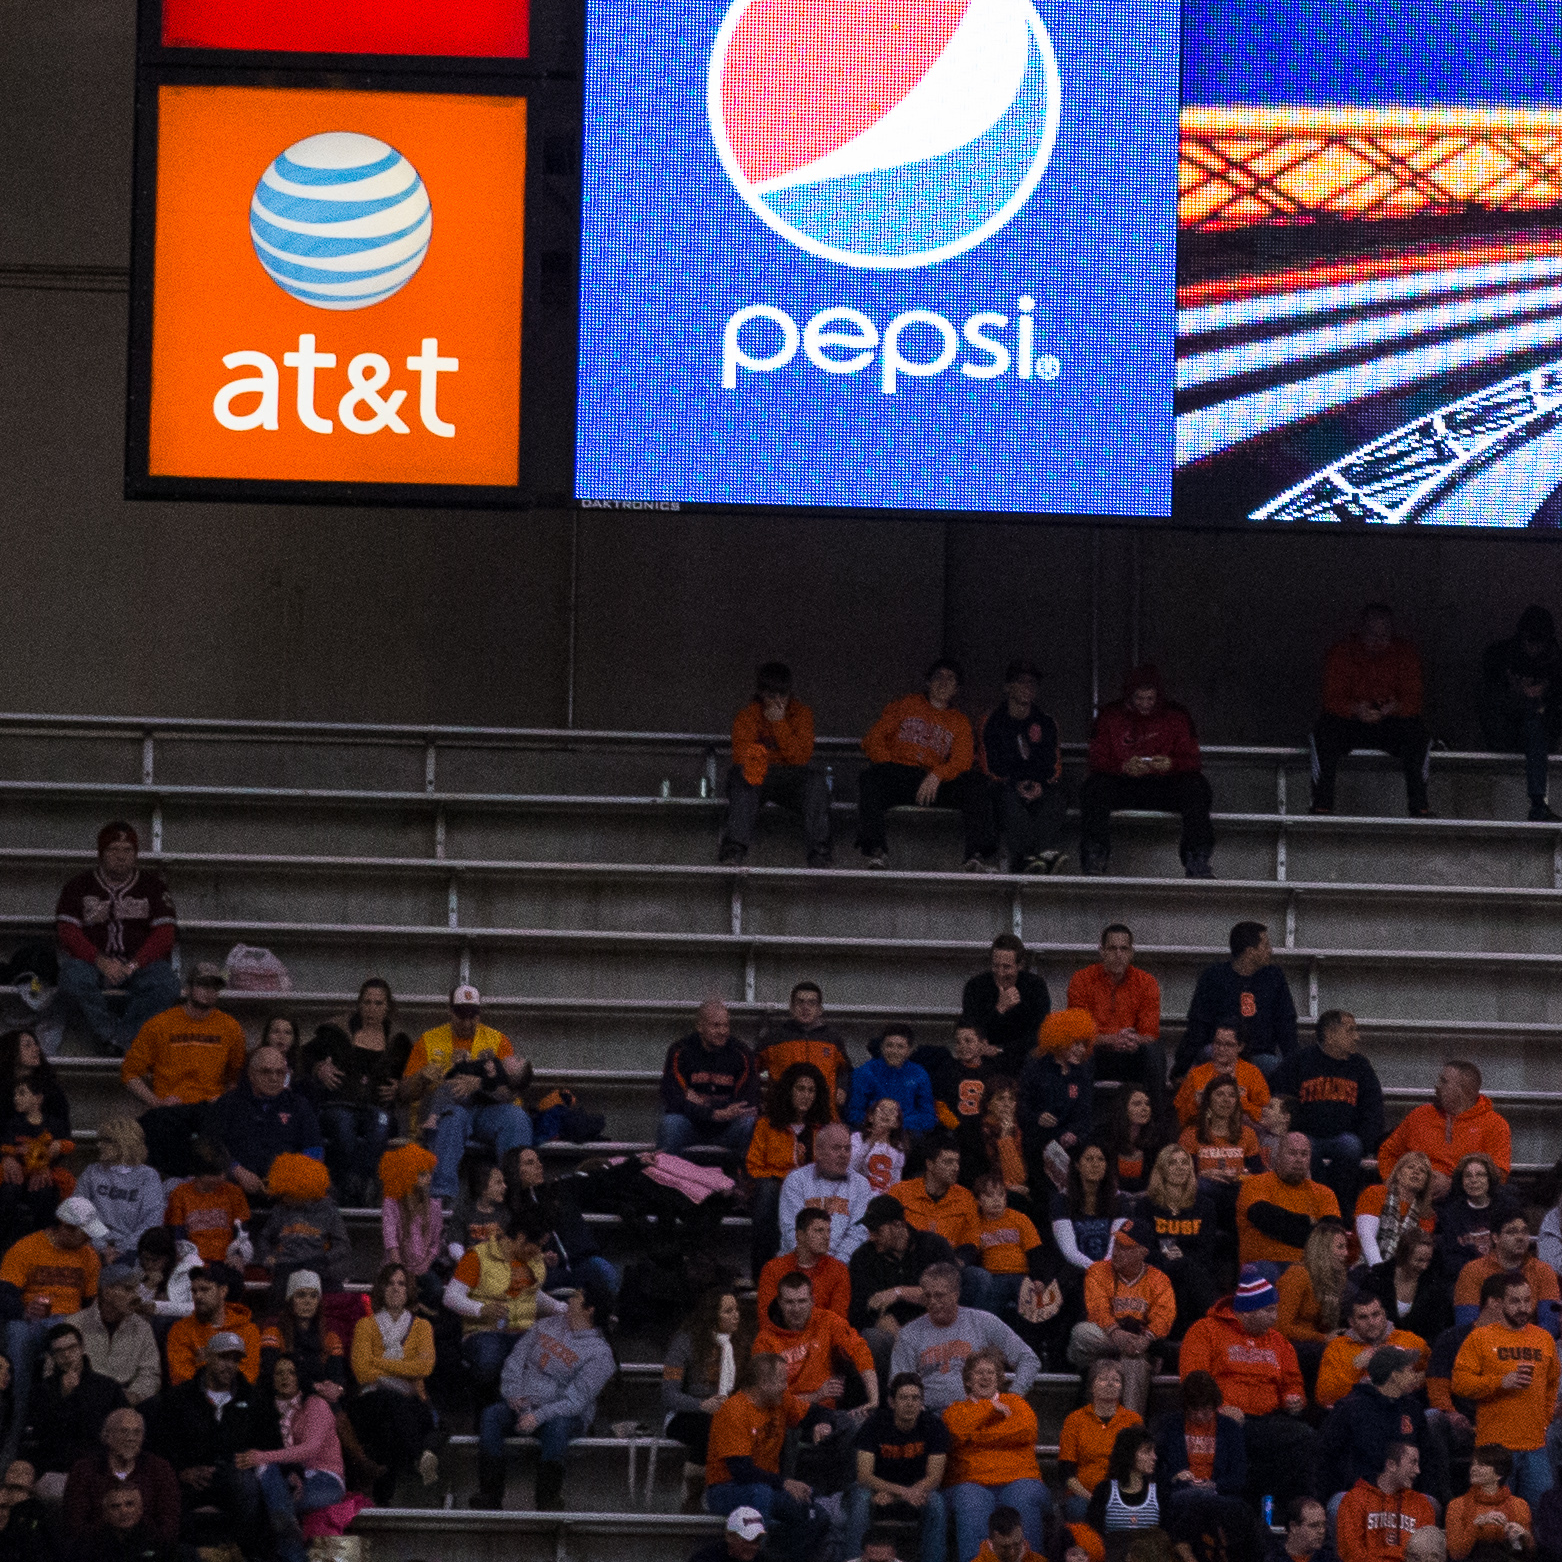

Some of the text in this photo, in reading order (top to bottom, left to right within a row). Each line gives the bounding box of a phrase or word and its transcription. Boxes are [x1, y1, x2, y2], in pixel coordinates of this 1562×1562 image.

[721, 295, 1037, 395] pepsi
[211, 333, 460, 438] at&t
[580, 499, 682, 512] DAKTRONICS
[867, 1153, 893, 1193] S
